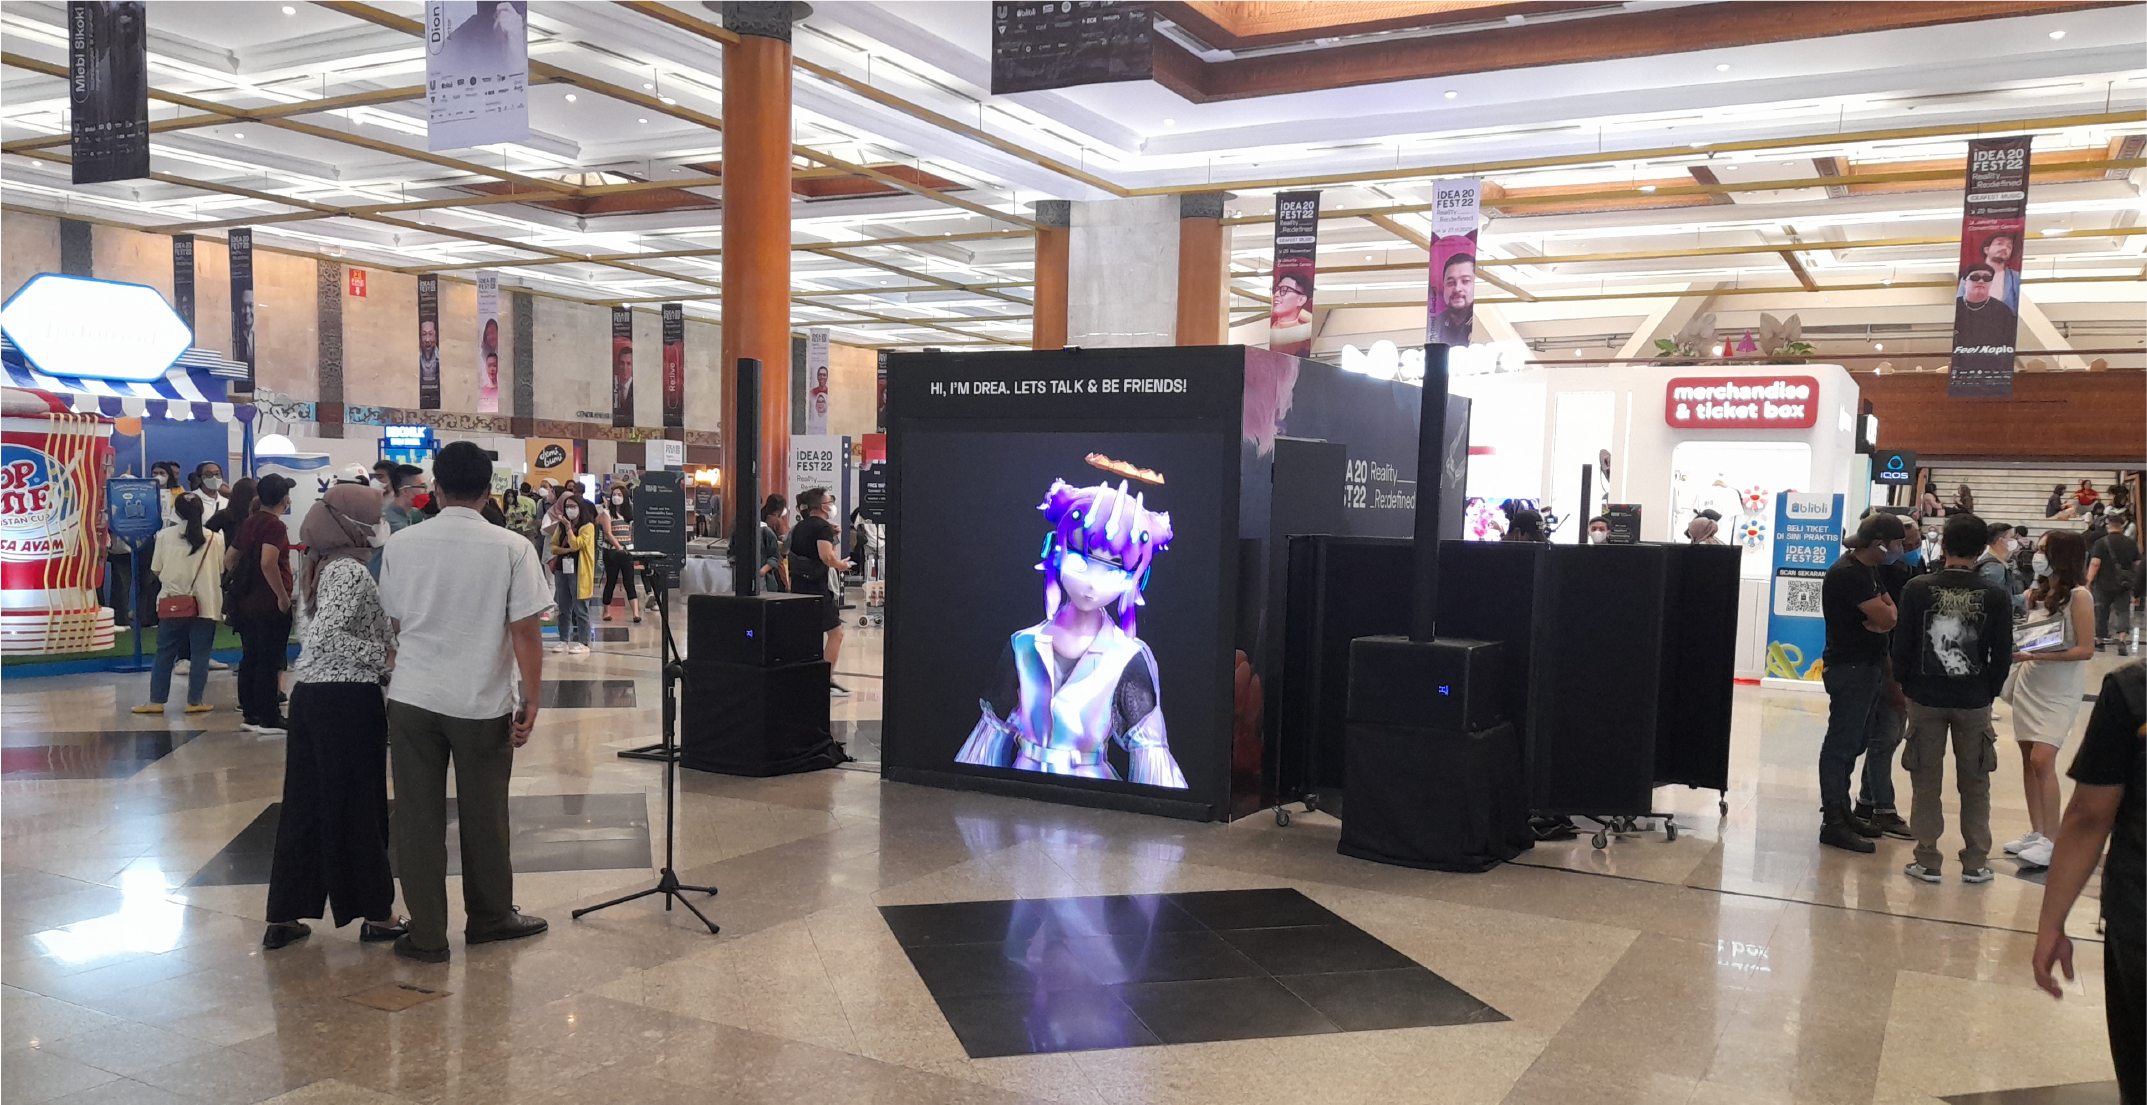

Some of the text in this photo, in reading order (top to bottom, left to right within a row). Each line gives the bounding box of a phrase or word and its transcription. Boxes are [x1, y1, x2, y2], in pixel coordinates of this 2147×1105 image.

[431, 6, 441, 43] Dion
[2007, 149, 2024, 159] 20
[1973, 159, 2023, 172] FEST 22
[1972, 172, 2000, 180] Reality
[1462, 189, 1474, 198] 20
[1303, 201, 1315, 210] 20
[1437, 198, 1473, 208] FEST 22
[1280, 210, 1314, 219] FEST 22
[1953, 345, 2014, 355] Feel Koplo
[930, 382, 947, 397] HI,
[973, 382, 1011, 395] DREA.
[1014, 380, 1047, 395] LETS
[1050, 379, 1084, 394] TALK
[1087, 379, 1098, 394] &
[1102, 379, 1120, 393] BE
[1124, 378, 1187, 393] FRIENDS!
[1673, 381, 1810, 400] merchandise
[1675, 401, 1804, 420] & ticket box
[539, 447, 558, 460] demi
[821, 451, 832, 460] 20
[544, 453, 562, 467] bumi
[797, 462, 832, 471] FEST 22
[1354, 460, 1368, 483] 20
[797, 475, 817, 483] Reality
[1371, 461, 1398, 487] Reality
[1353, 485, 1366, 508] 22
[1800, 503, 1828, 513] blibli
[1806, 525, 1829, 533] TIKET
[1776, 532, 1784, 540] DI
[1804, 534, 1838, 542] PRAKTIS
[1813, 546, 1826, 555] 20
[1785, 554, 1825, 564] FEST 22
